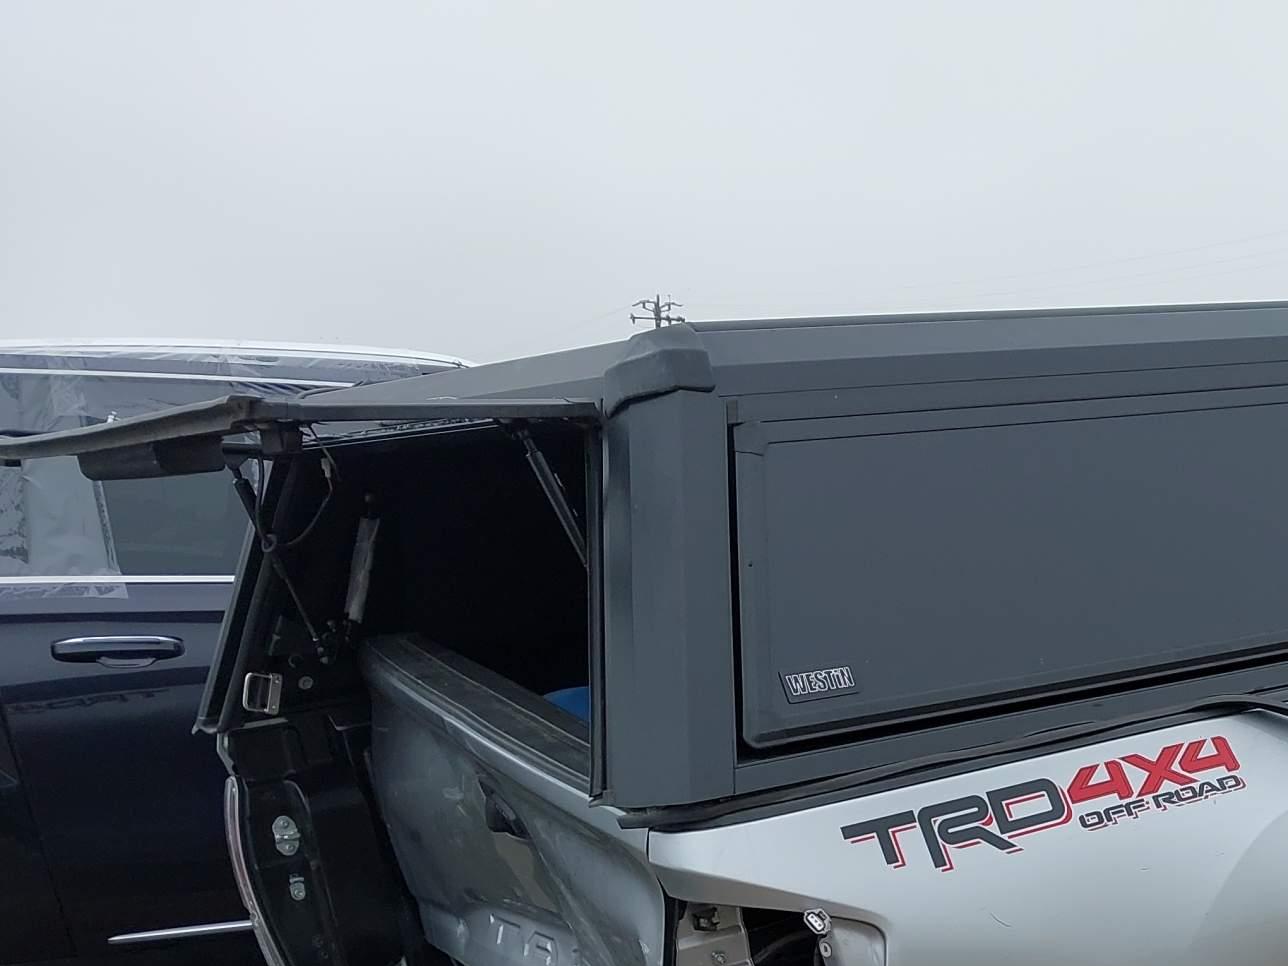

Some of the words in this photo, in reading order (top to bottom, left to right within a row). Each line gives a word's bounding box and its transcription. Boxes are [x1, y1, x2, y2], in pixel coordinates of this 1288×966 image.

[840, 777, 1073, 873] TRD
[1079, 799, 1148, 831] OFF
[1152, 774, 1247, 810] ROAD
